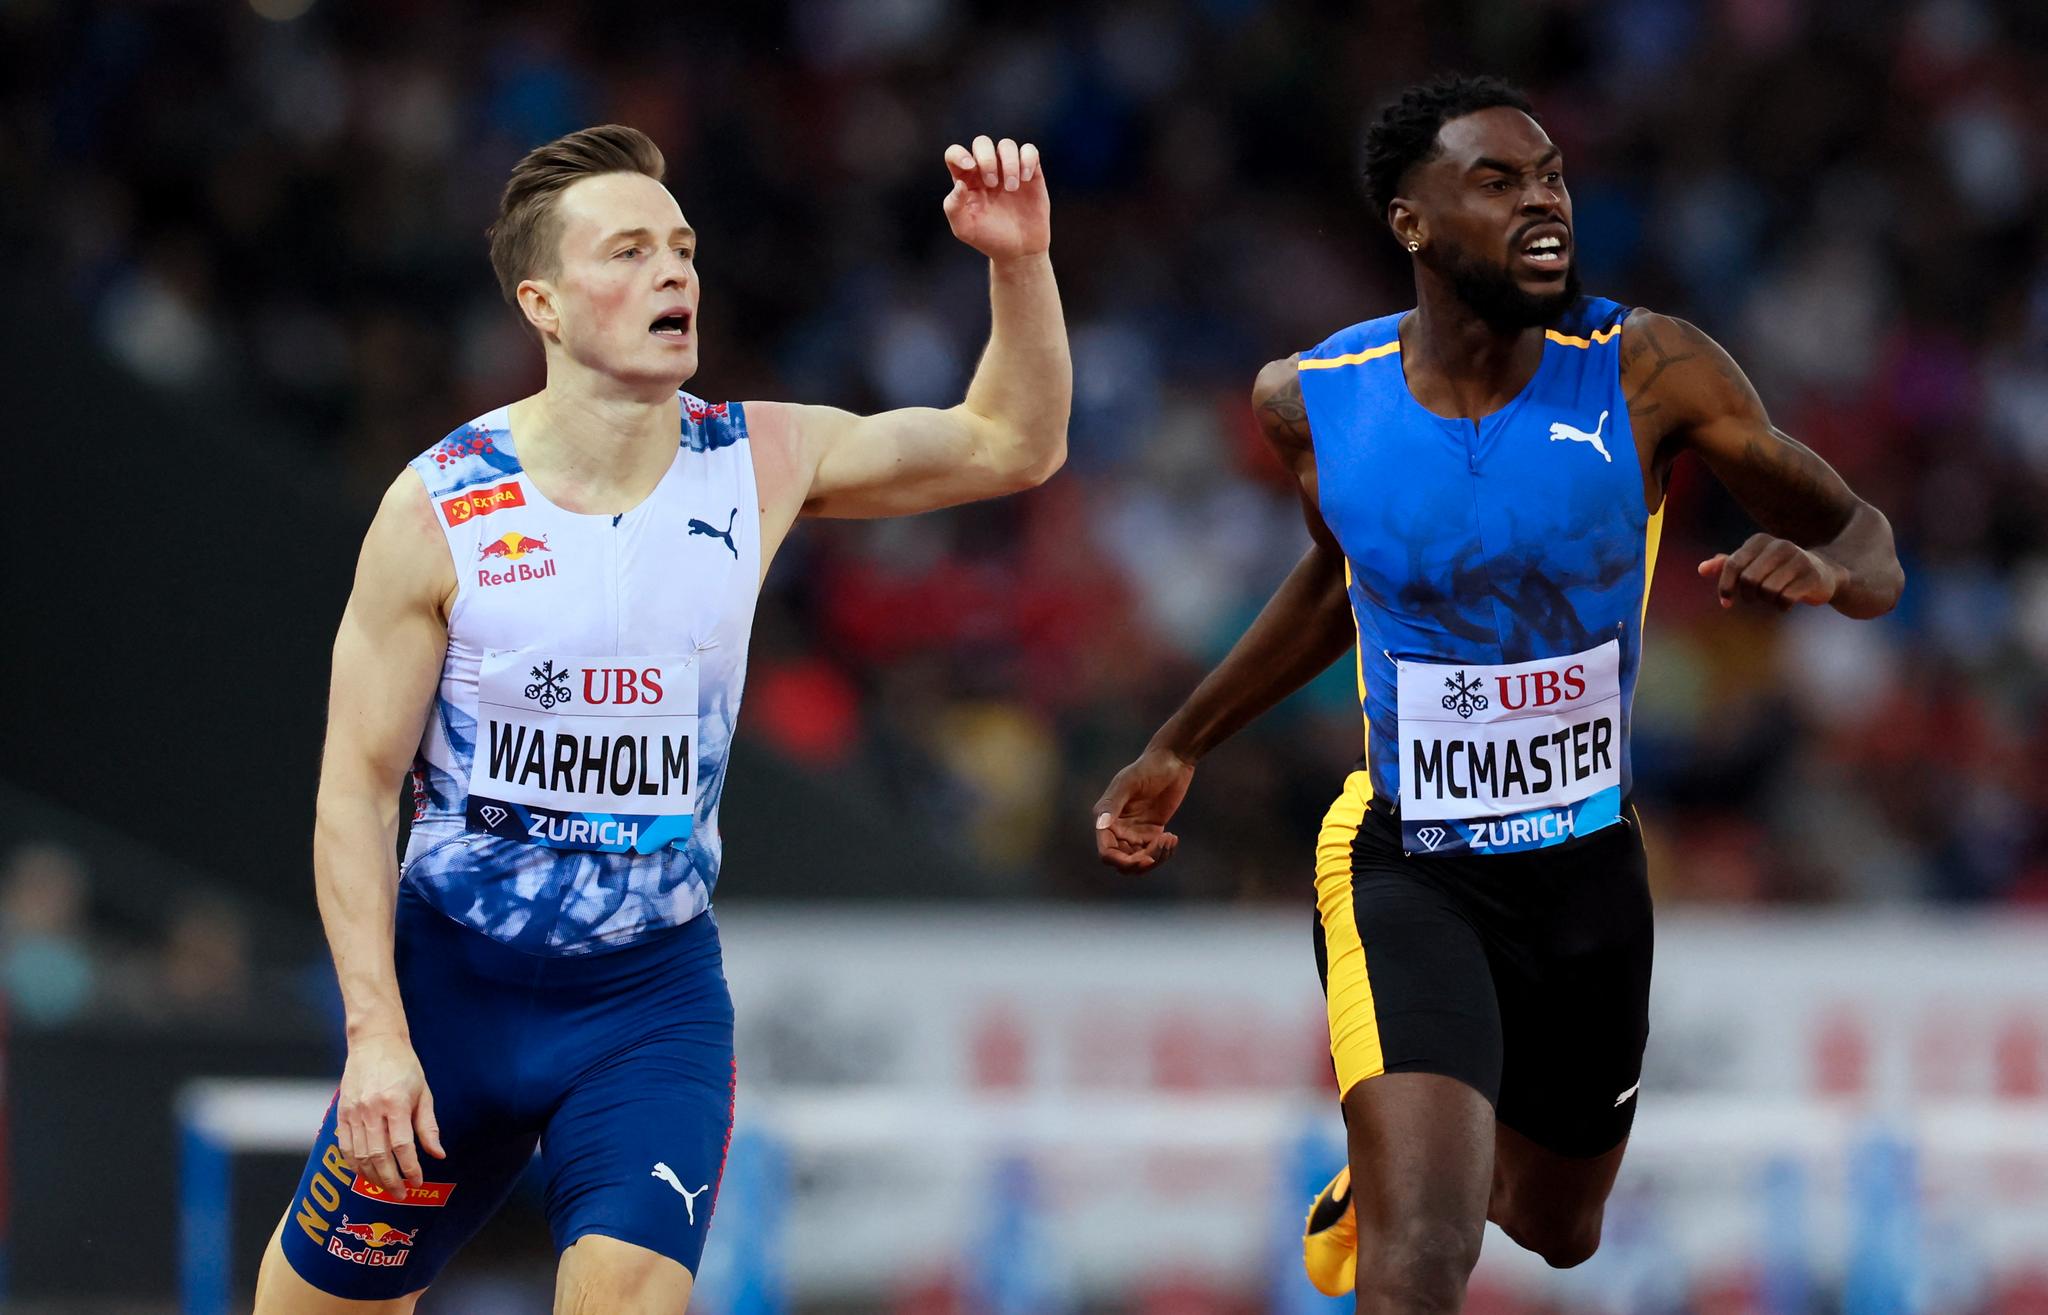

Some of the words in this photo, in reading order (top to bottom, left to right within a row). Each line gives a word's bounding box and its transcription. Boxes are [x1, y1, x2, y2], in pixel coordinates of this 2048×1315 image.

[473, 490, 516, 508] EXTRA
[478, 565, 516, 587] Red
[519, 559, 556, 582] Bull
[581, 668, 663, 705] UBS
[1495, 664, 1586, 711] UBS
[489, 720, 689, 796] WARHOLM
[1413, 717, 1612, 800] MCMASTER
[528, 813, 638, 846] ZURICH
[1468, 810, 1574, 849] ZURICH
[296, 1127, 352, 1246] NOR
[327, 1235, 371, 1265] Red
[368, 1250, 409, 1266] Bull
